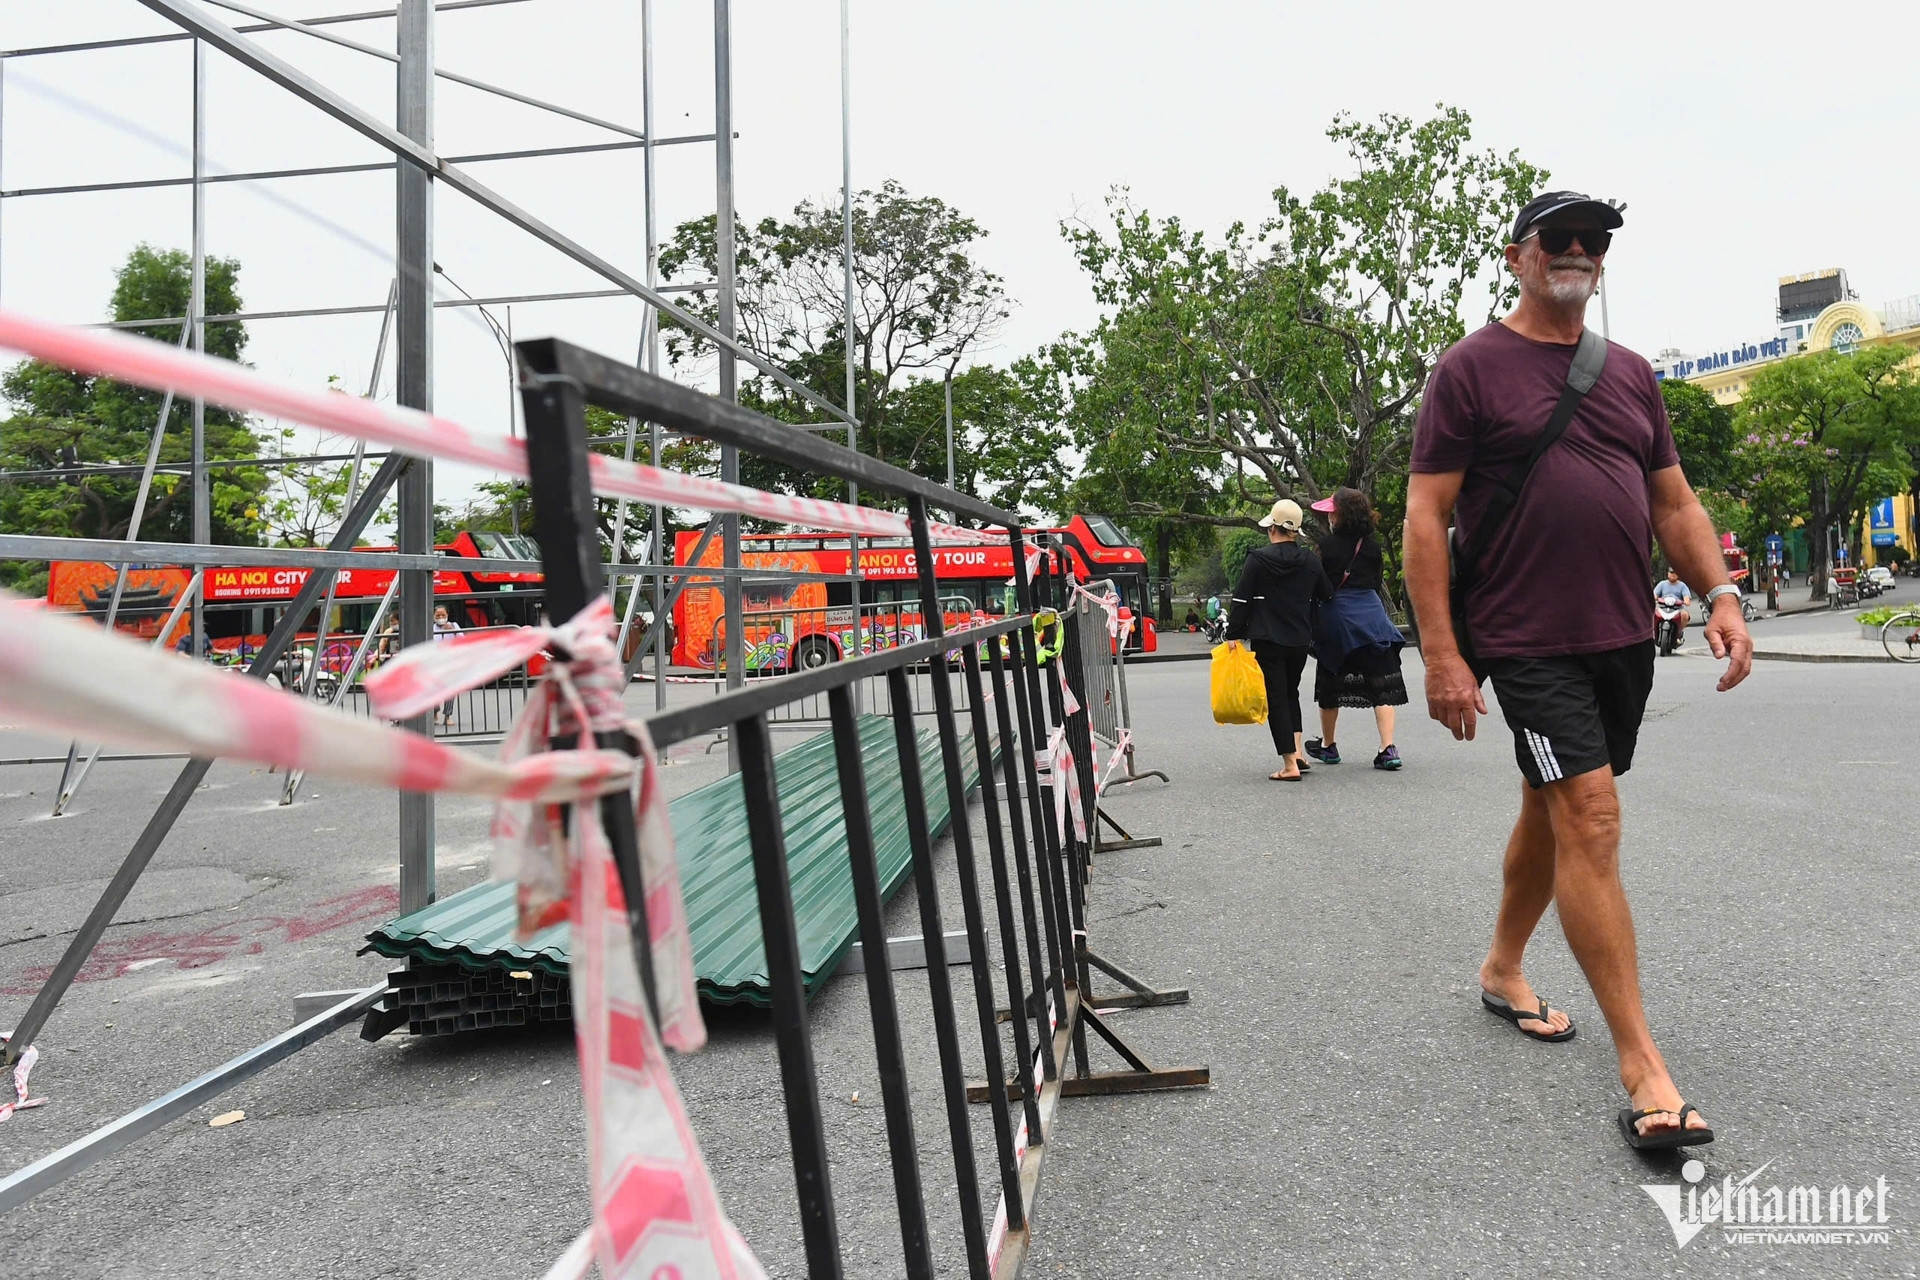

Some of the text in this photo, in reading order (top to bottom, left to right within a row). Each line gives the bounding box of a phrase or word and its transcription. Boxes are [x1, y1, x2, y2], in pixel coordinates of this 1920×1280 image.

[1672, 337, 1788, 378] TẬP ĐOÀN BẢO VIỆT
[846, 552, 985, 567] HANOI CY TOUR
[215, 573, 237, 585] HA
[241, 572, 267, 584] NOI
[274, 571, 307, 584] CITY
[883, 567, 895, 575] 193
